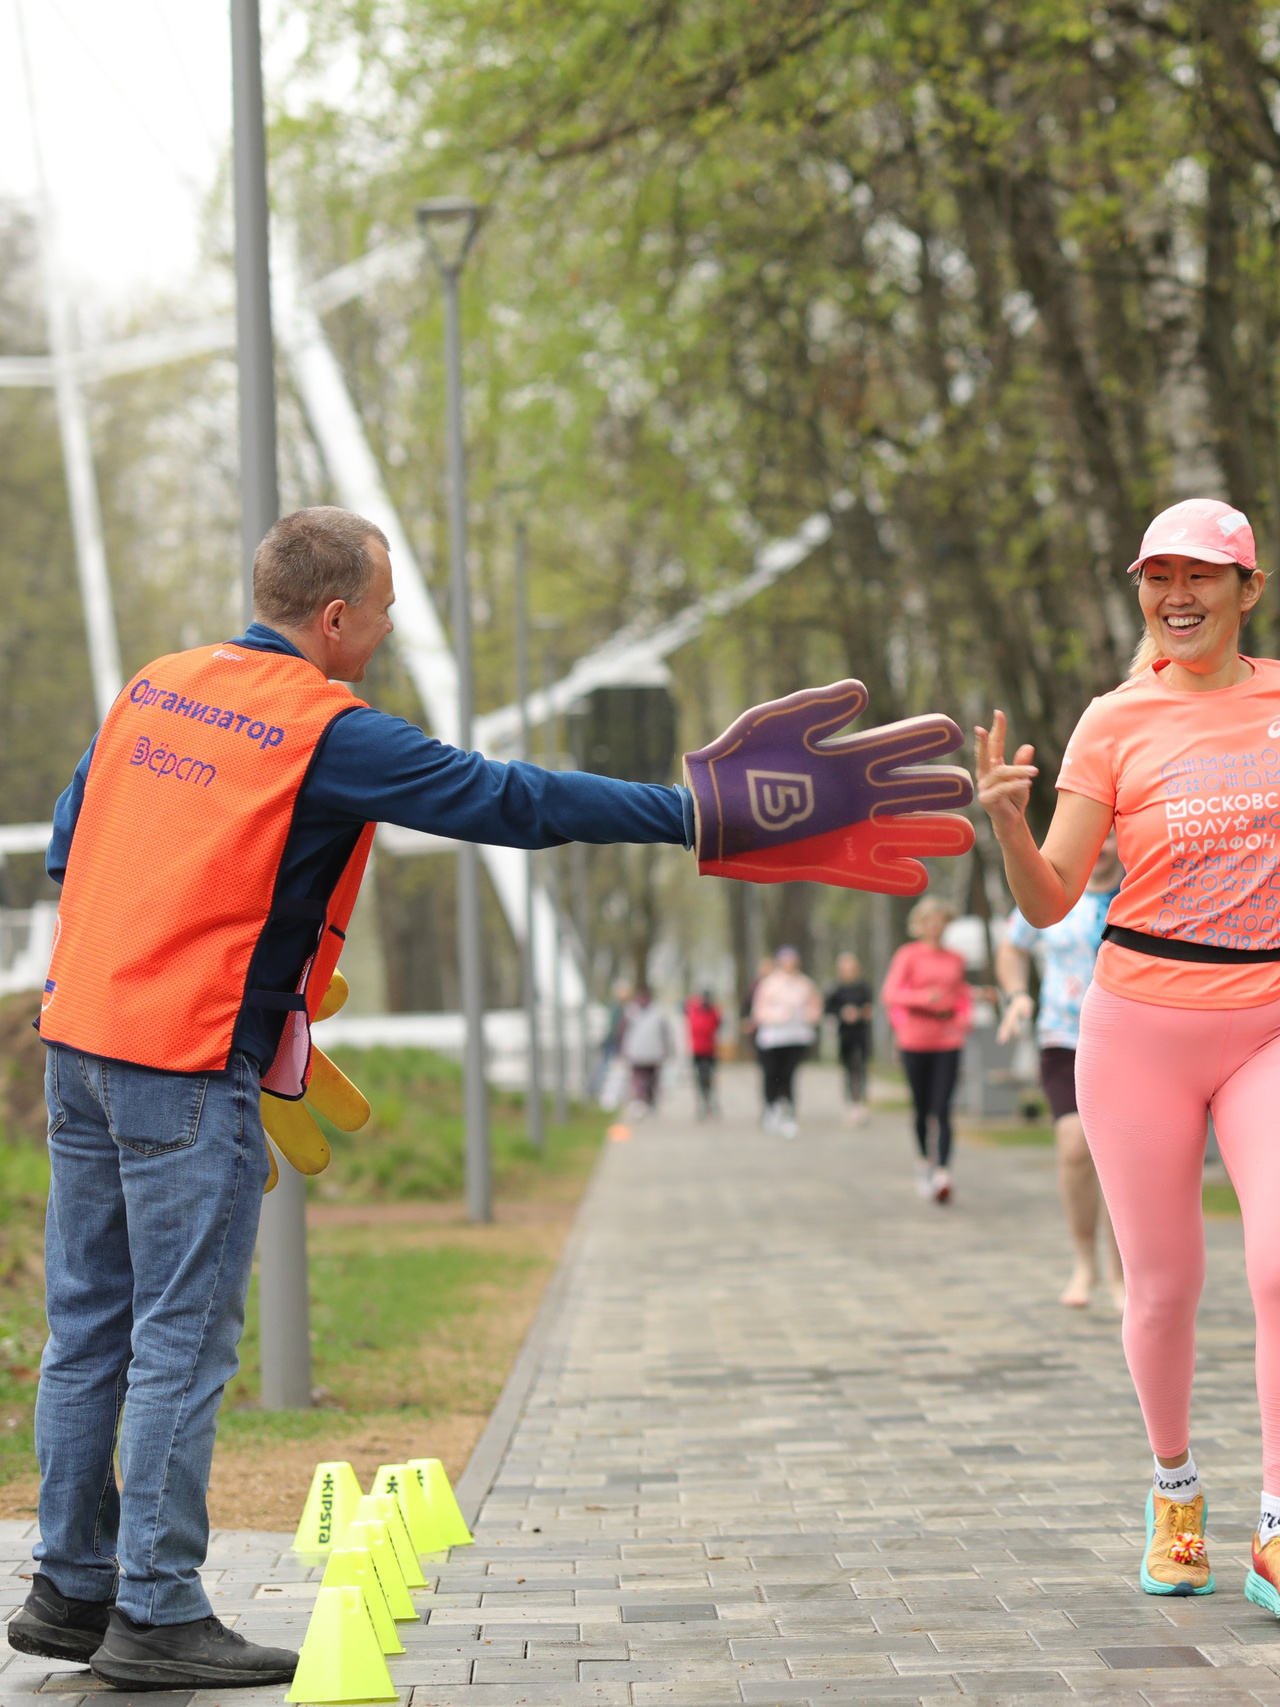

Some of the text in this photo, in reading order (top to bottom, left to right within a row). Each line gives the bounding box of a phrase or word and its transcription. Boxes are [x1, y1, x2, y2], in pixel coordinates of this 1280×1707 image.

[130, 679, 285, 749] Организатор
[1167, 817, 1232, 839] ПОЛУ
[1169, 833, 1276, 857] МАРАФОН
[1150, 922, 1252, 950] 1905.2019
